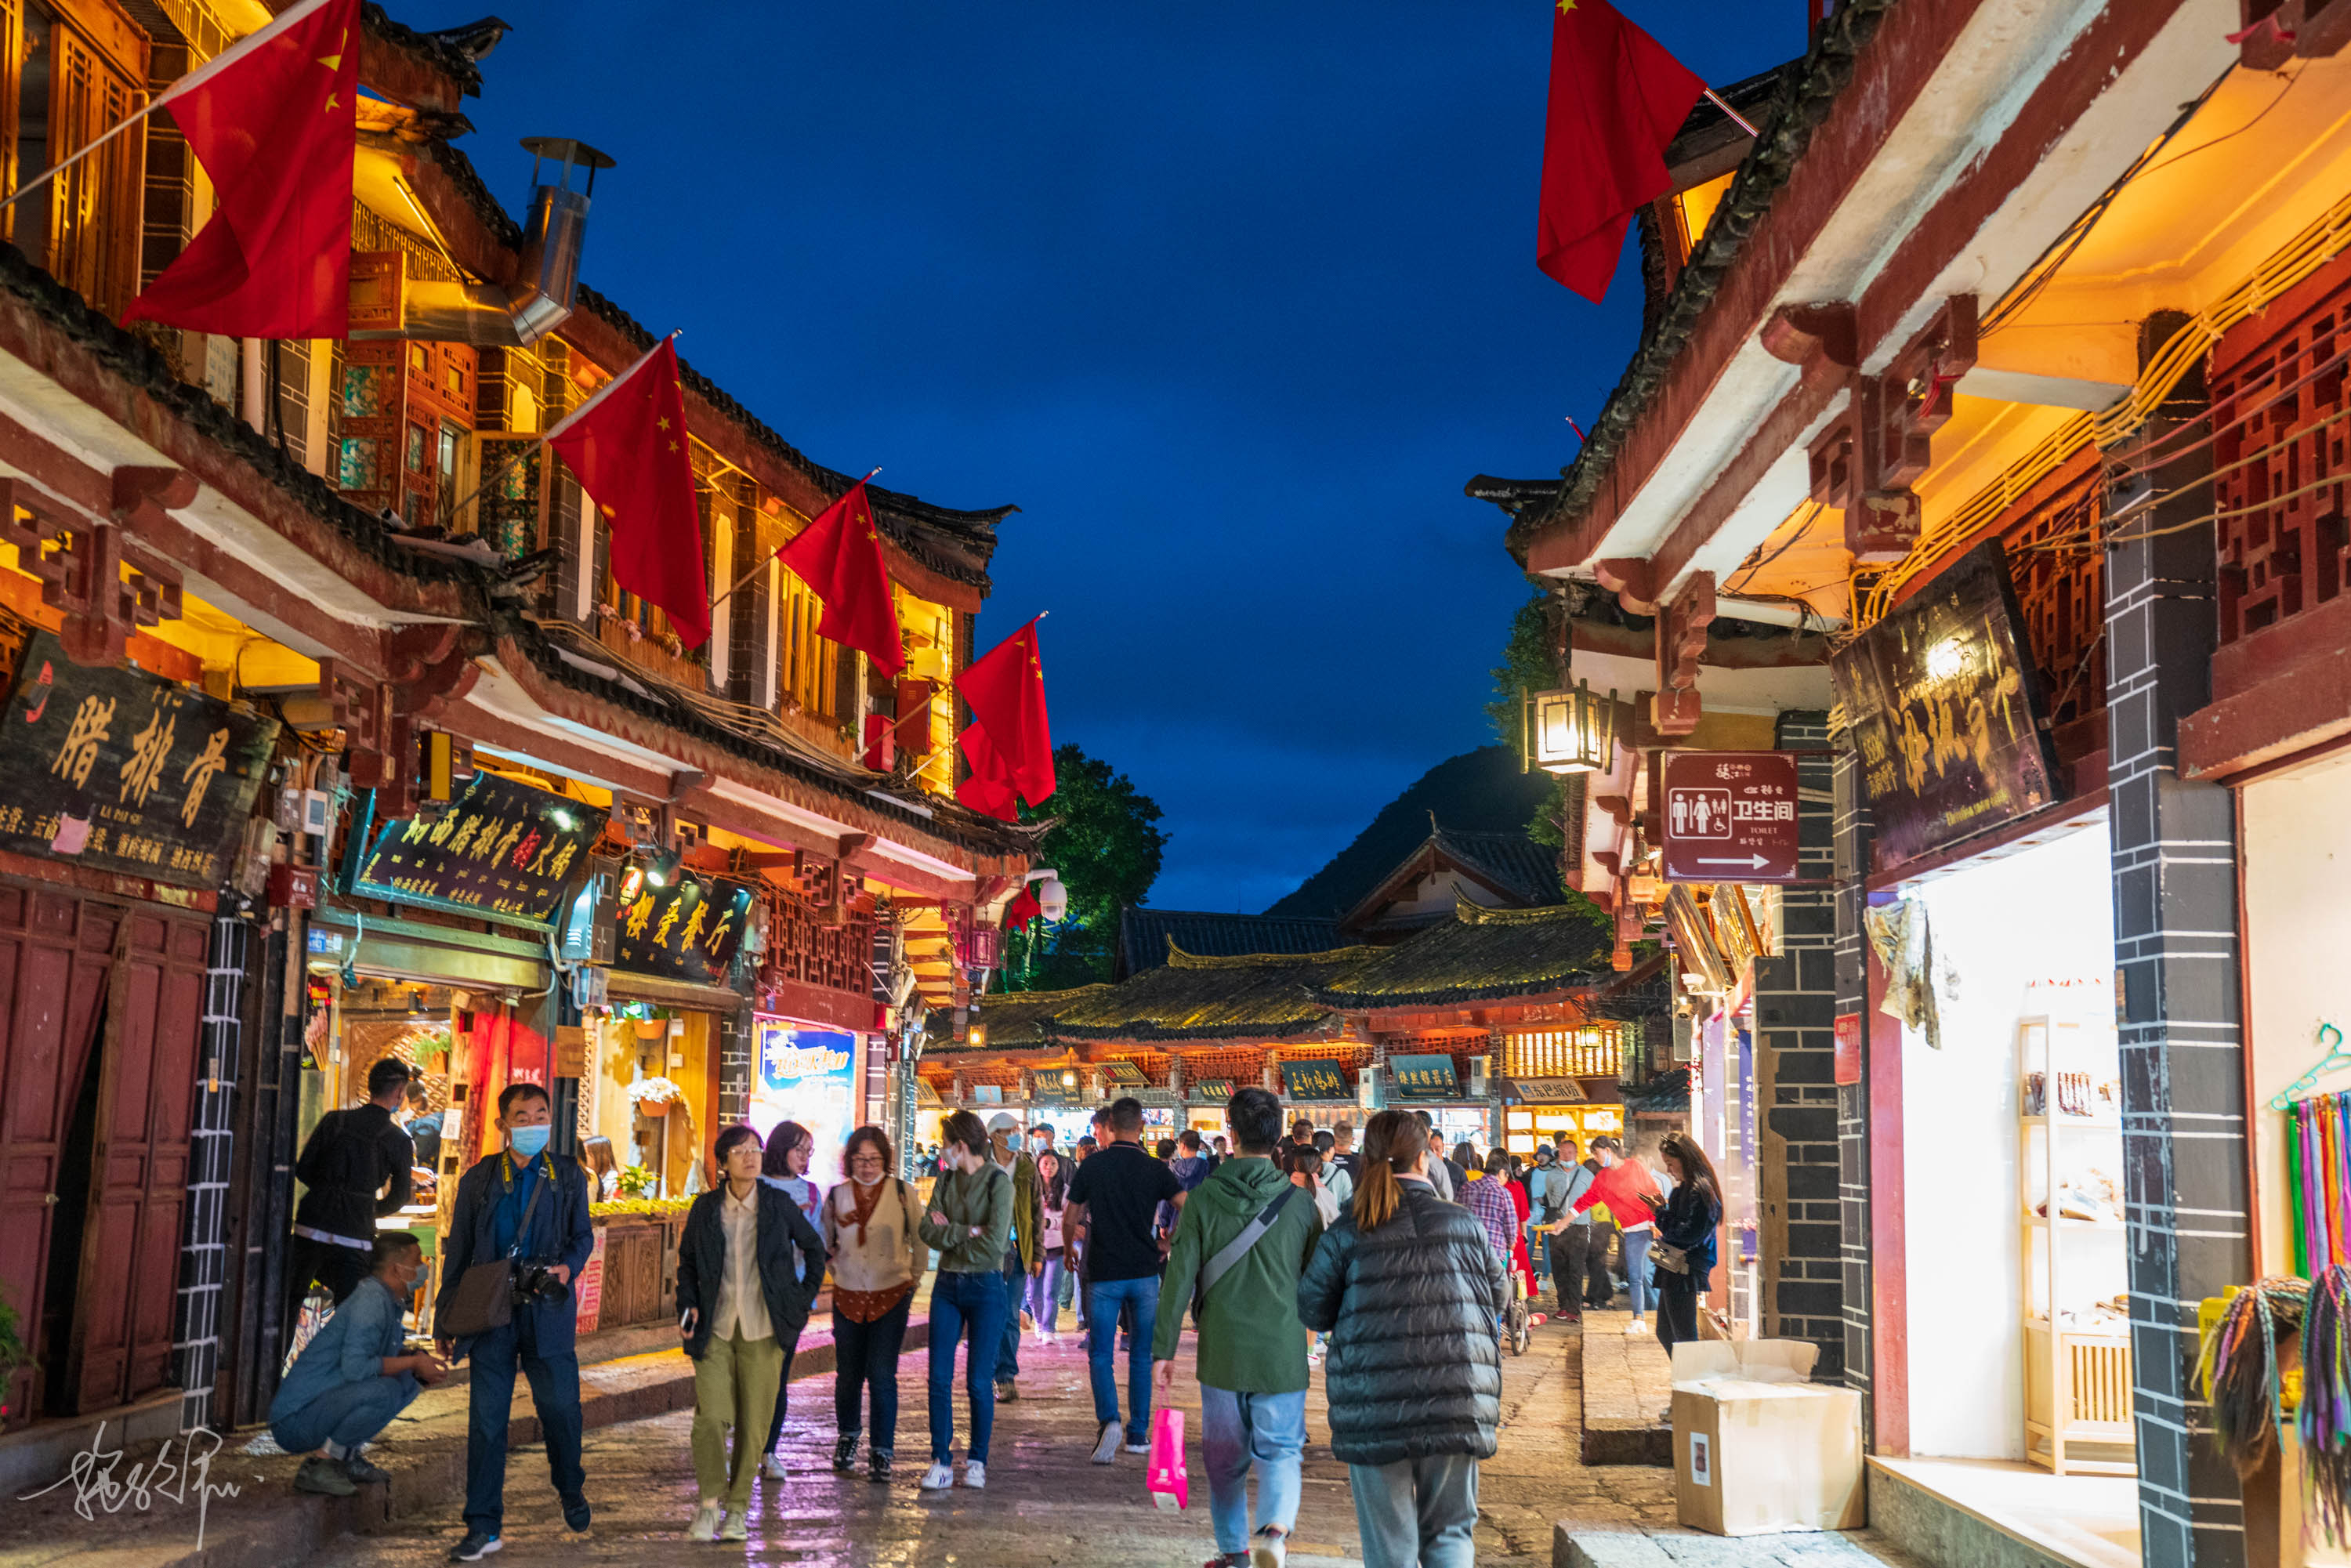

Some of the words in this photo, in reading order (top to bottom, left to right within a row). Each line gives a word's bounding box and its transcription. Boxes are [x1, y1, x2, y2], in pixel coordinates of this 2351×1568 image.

[51, 694, 230, 828] 腊排骨
[1733, 800, 1794, 821] 卫生间
[1749, 826, 1777, 835] TOILET
